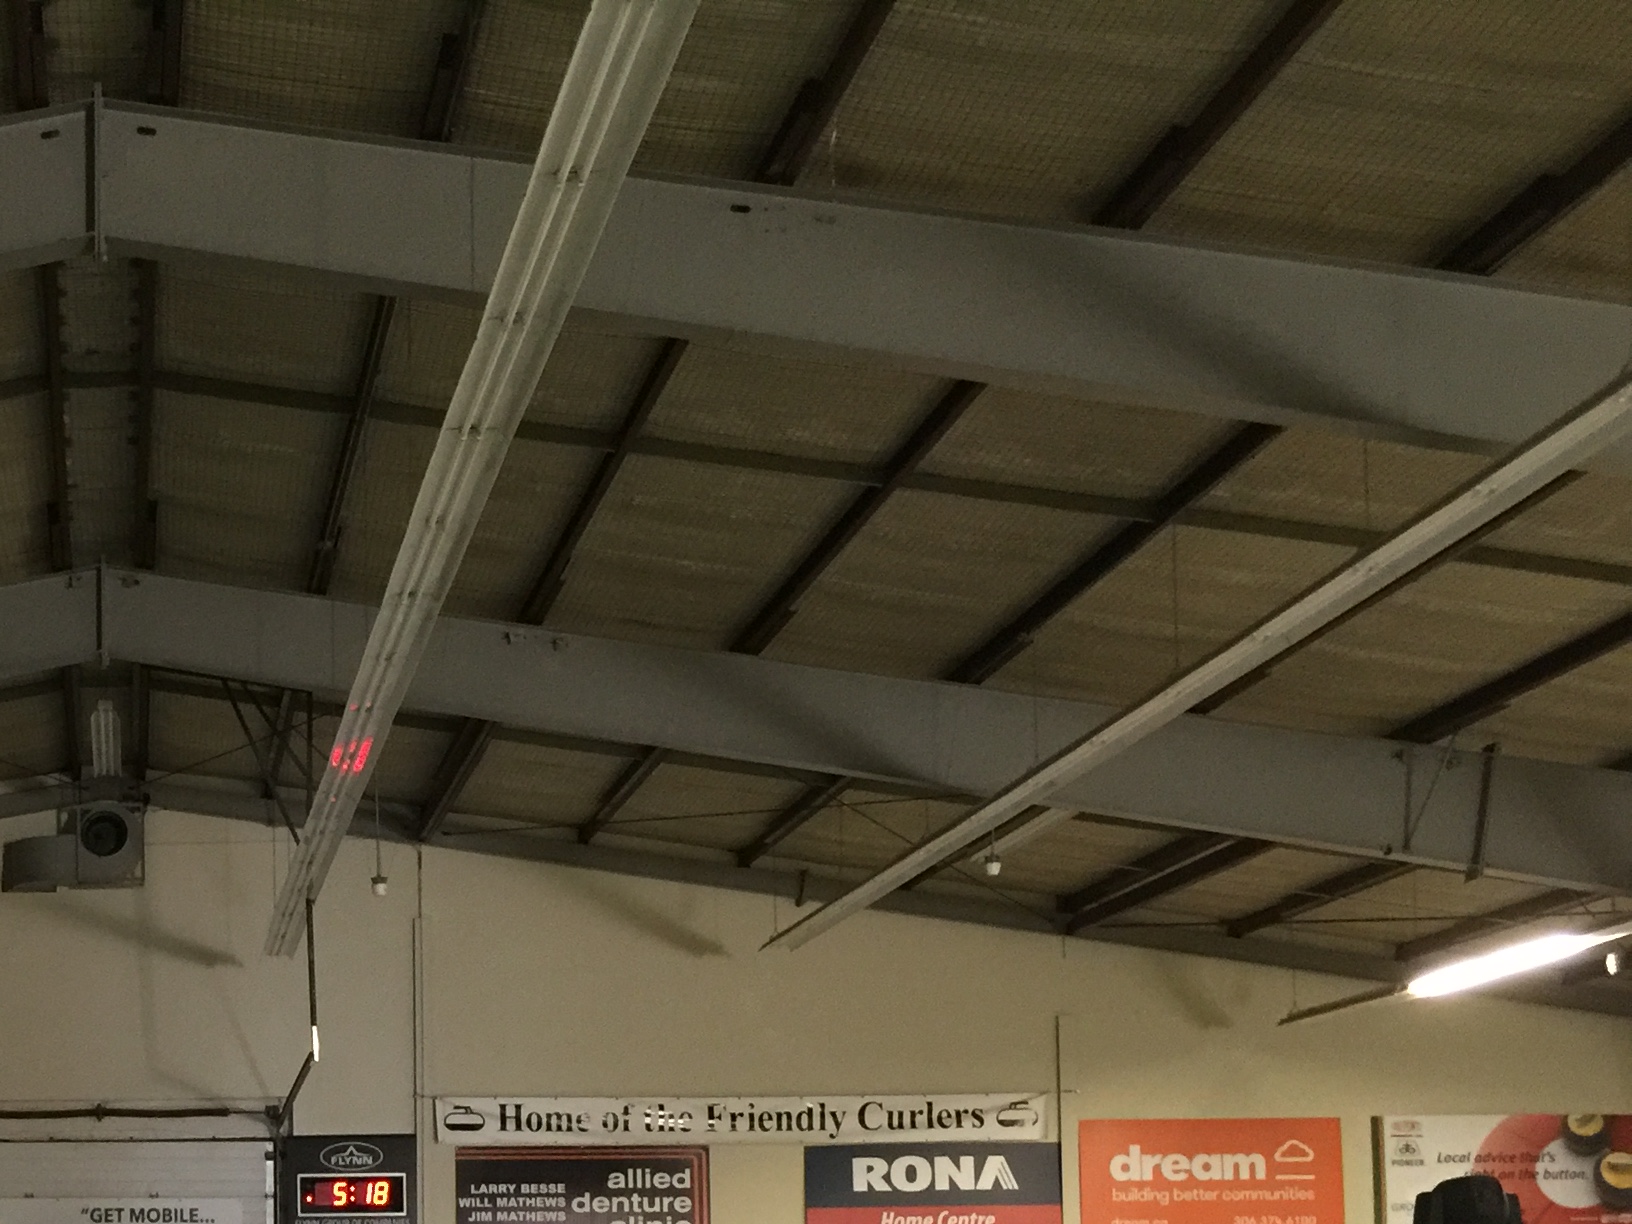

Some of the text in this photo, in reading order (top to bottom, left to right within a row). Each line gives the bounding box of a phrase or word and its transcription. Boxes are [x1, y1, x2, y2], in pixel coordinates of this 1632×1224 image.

[498, 1101, 985, 1139] Home of the Friendly Curlers
[331, 1156, 373, 1165] FLYNN
[1109, 1144, 1267, 1182] dream
[1391, 1159, 1425, 1167] PIONEER
[1437, 1152, 1556, 1164] Local advice that's
[607, 1168, 691, 1189] allied
[852, 1155, 1019, 1192] RONA
[1498, 1171, 1514, 1181] on
[1518, 1169, 1539, 1181] the
[1543, 1169, 1590, 1181] button.
[333, 1181, 389, 1206] 5:18
[470, 1183, 566, 1194] LARRY BESSE
[1112, 1187, 1315, 1205] building better communities
[458, 1197, 566, 1208] WILL MATHEWS
[571, 1192, 693, 1214] denture
[468, 1211, 566, 1222] JIM MATHEWS
